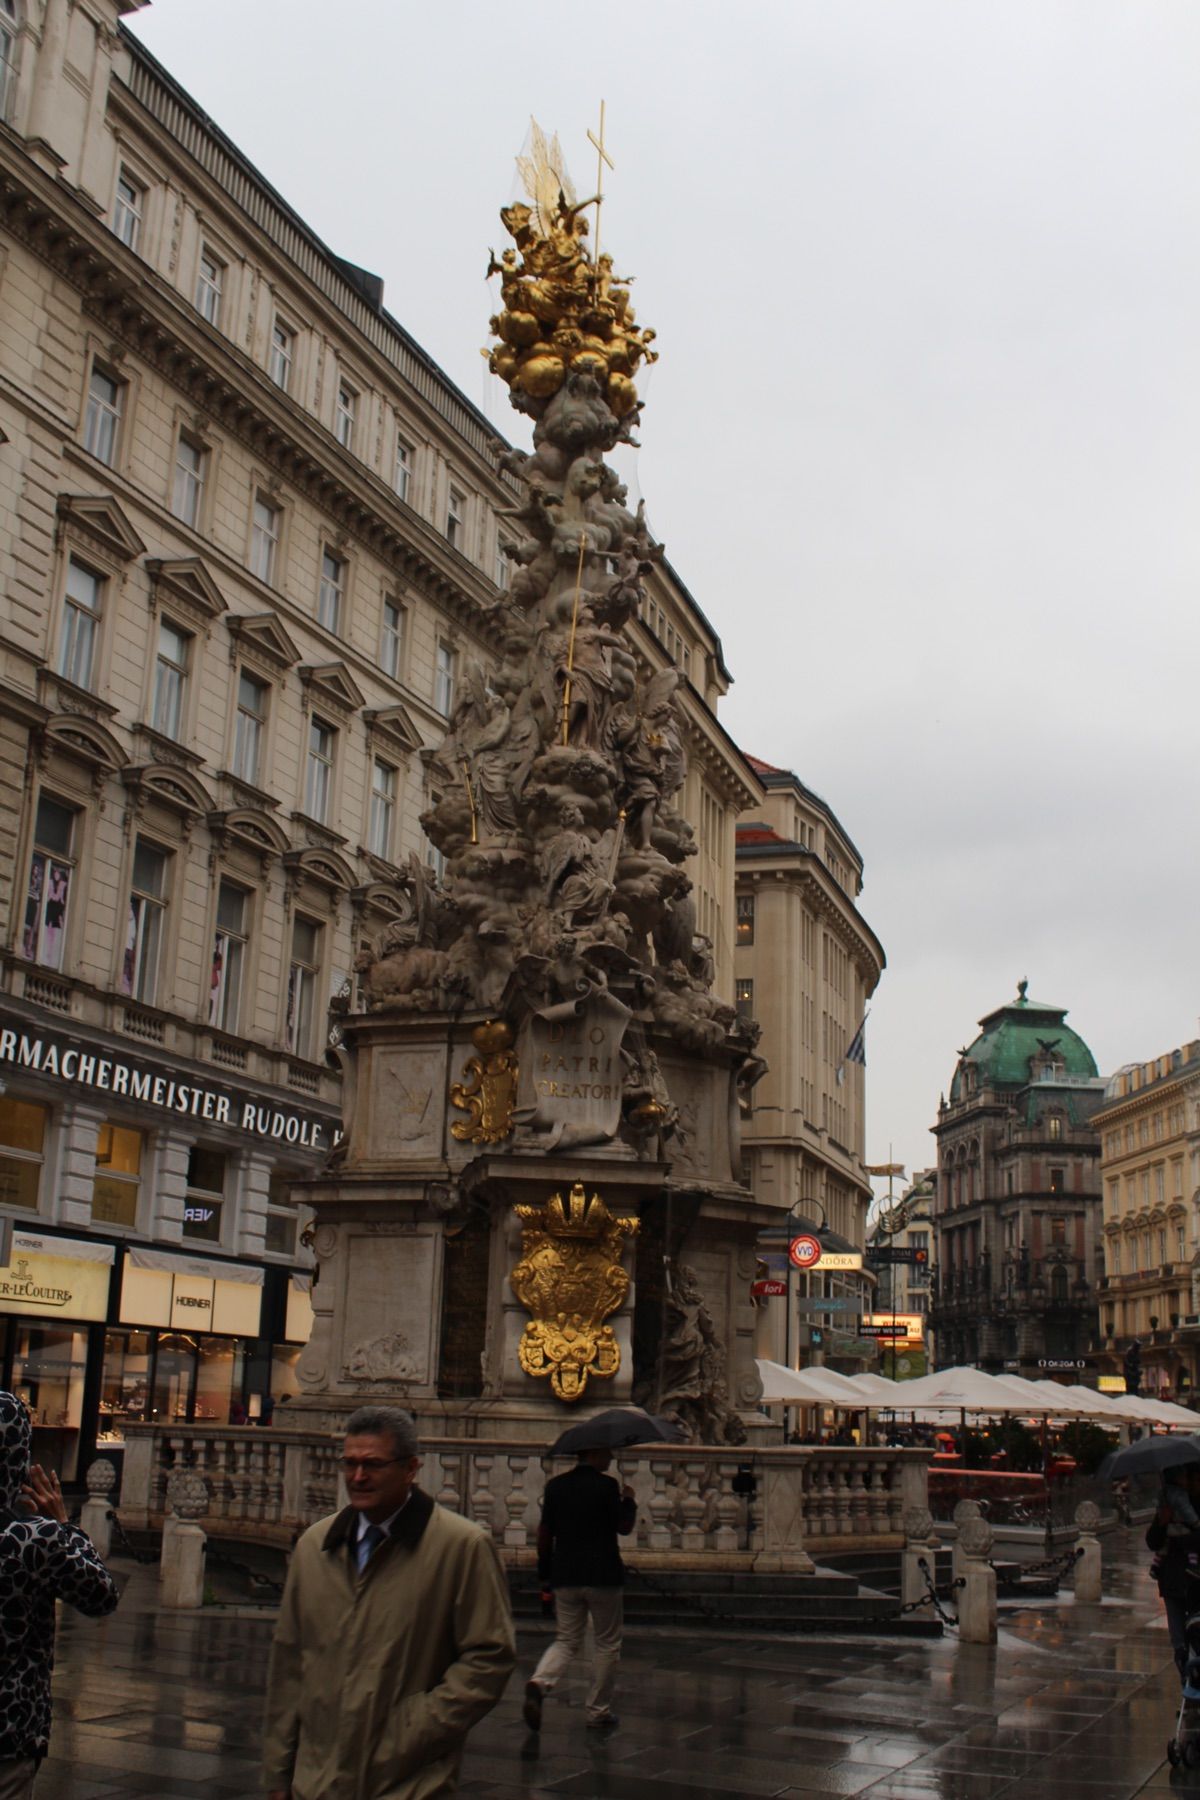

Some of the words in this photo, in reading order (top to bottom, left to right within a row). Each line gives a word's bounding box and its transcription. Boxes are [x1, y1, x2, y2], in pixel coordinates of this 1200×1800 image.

[542, 1053, 612, 1073] PATRI
[539, 1080, 620, 1101] CREATORI
[242, 1103, 322, 1147] RUDOLF
[819, 1256, 853, 1265] NDORA
